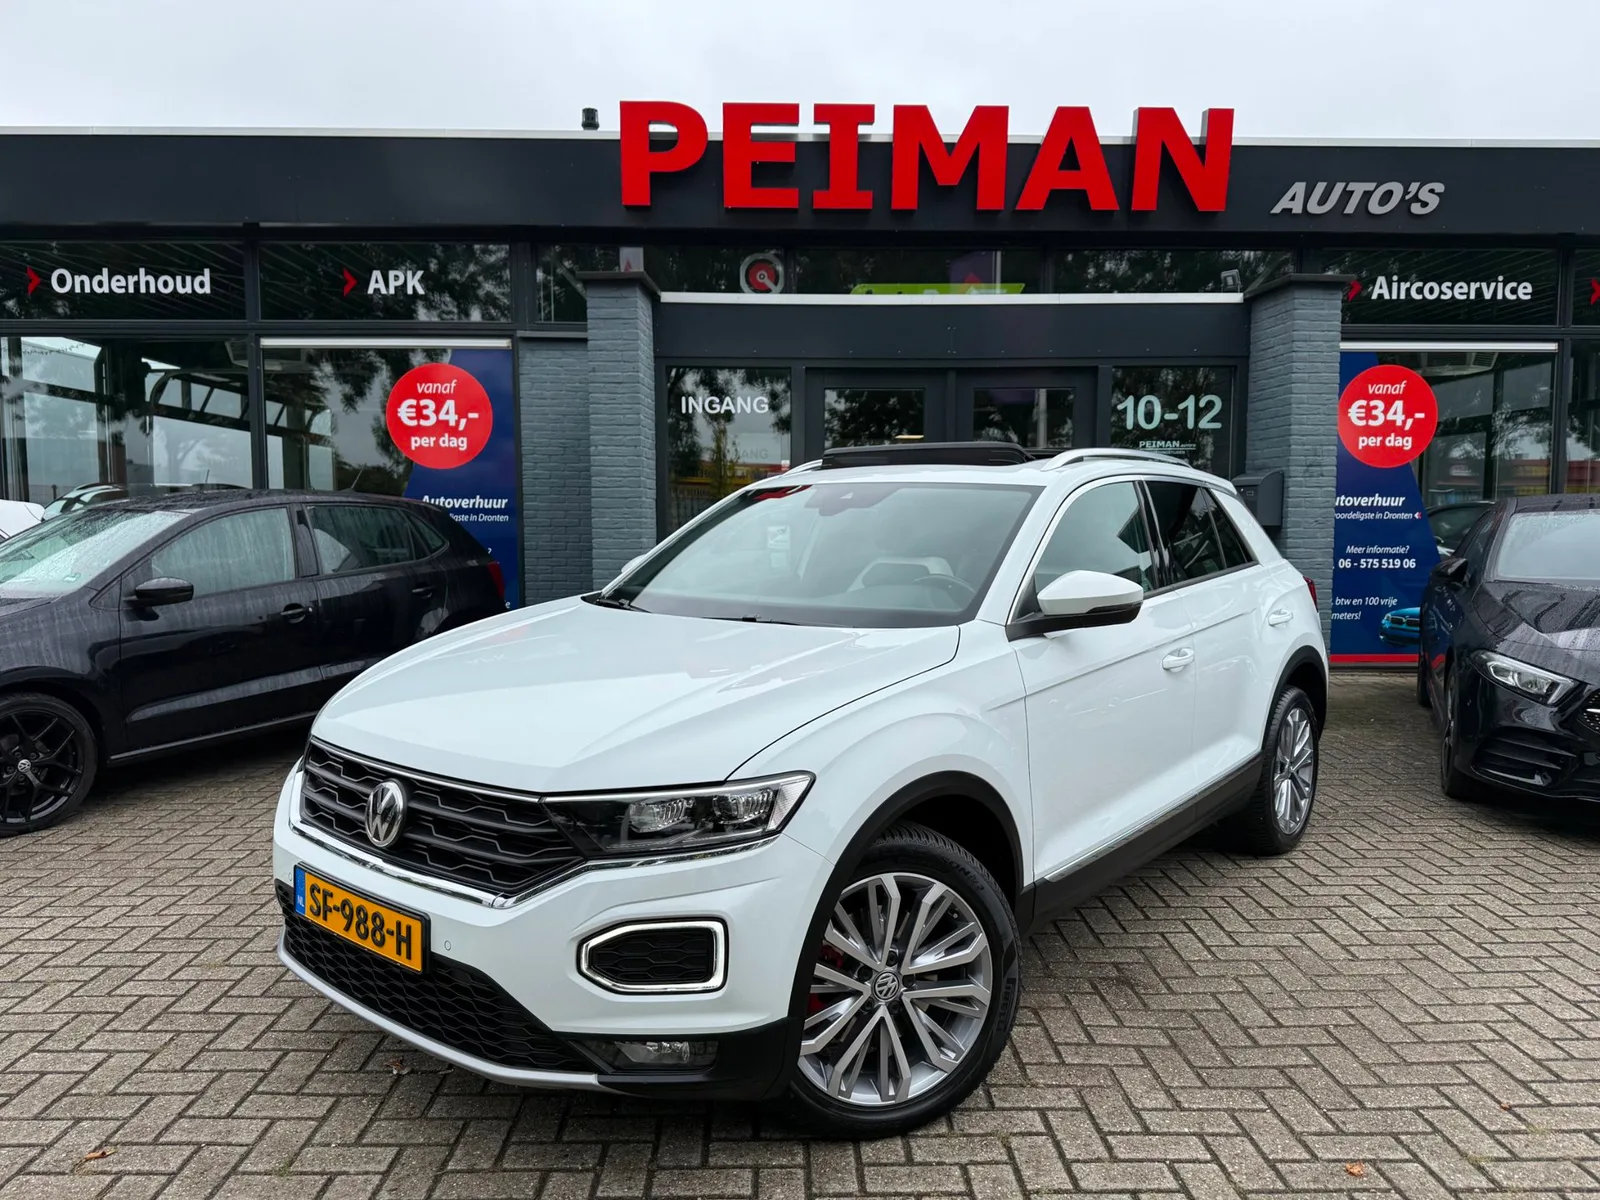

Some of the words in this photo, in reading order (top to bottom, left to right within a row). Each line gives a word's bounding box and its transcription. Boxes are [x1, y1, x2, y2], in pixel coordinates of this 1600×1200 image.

[619, 100, 1235, 212] PEIMAN
[1270, 181, 1446, 216] AUTO'S
[50, 267, 212, 294] Onderhoud
[367, 269, 426, 295] APK
[1371, 275, 1533, 300] Aircoservice
[416, 379, 457, 394] vanaf
[1368, 380, 1407, 395] vanaf
[681, 395, 769, 414] INGANG
[1116, 394, 1223, 430] 10-12
[397, 398, 480, 431] €34,-
[1347, 399, 1426, 431] €34,-
[411, 436, 437, 451] per
[439, 433, 468, 451] dag
[1139, 440, 1180, 448] PEIMAN
[1358, 436, 1383, 450] per
[1385, 433, 1413, 451] dag
[470, 512, 477, 522] in
[478, 513, 510, 522] Dronten
[1375, 511, 1383, 520] in
[1383, 511, 1413, 520] Dronten
[1346, 546, 1366, 554] Meer
[1366, 545, 1410, 555] informatie?
[1338, 558, 1352, 569] 06
[1360, 558, 1380, 569] 575
[1381, 558, 1401, 569] 519
[1402, 558, 1417, 569] 06
[1335, 596, 1352, 605] btw
[1364, 596, 1379, 605] 100
[1380, 597, 1398, 607] vrije
[1331, 611, 1362, 620] meters!
[309, 883, 412, 960] SF-988-H
